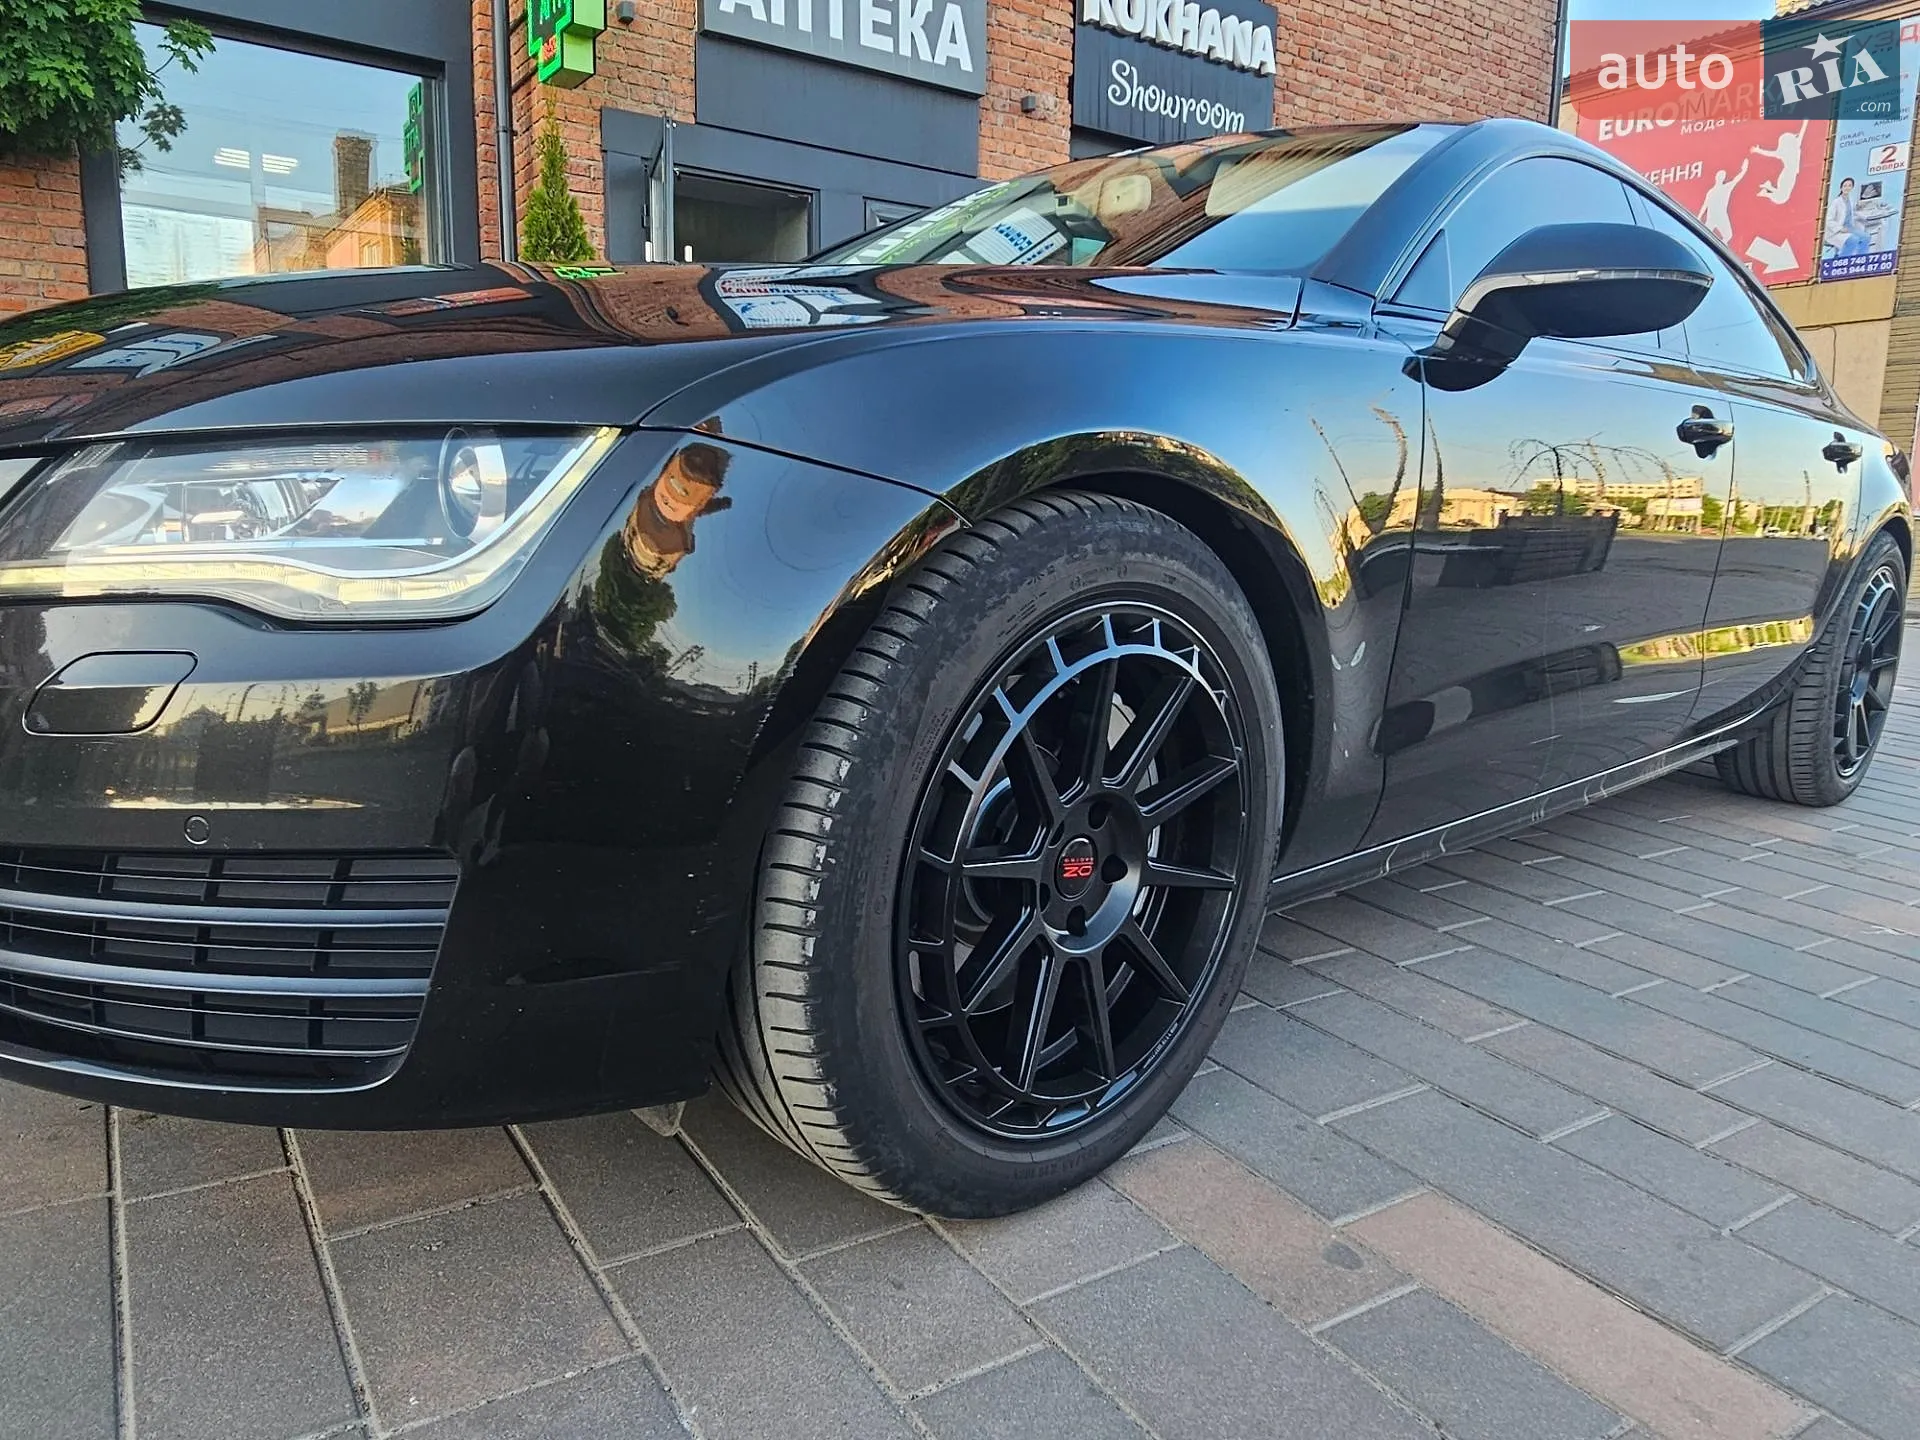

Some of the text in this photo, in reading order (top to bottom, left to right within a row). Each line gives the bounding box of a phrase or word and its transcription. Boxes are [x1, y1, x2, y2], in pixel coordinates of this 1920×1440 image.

[1107, 59, 1245, 134] Showroom
[1680, 117, 1725, 136] мода
[1880, 146, 1898, 164] 2
[1644, 160, 1703, 186] ЕННЯ
[1063, 865, 1093, 878] OZ
